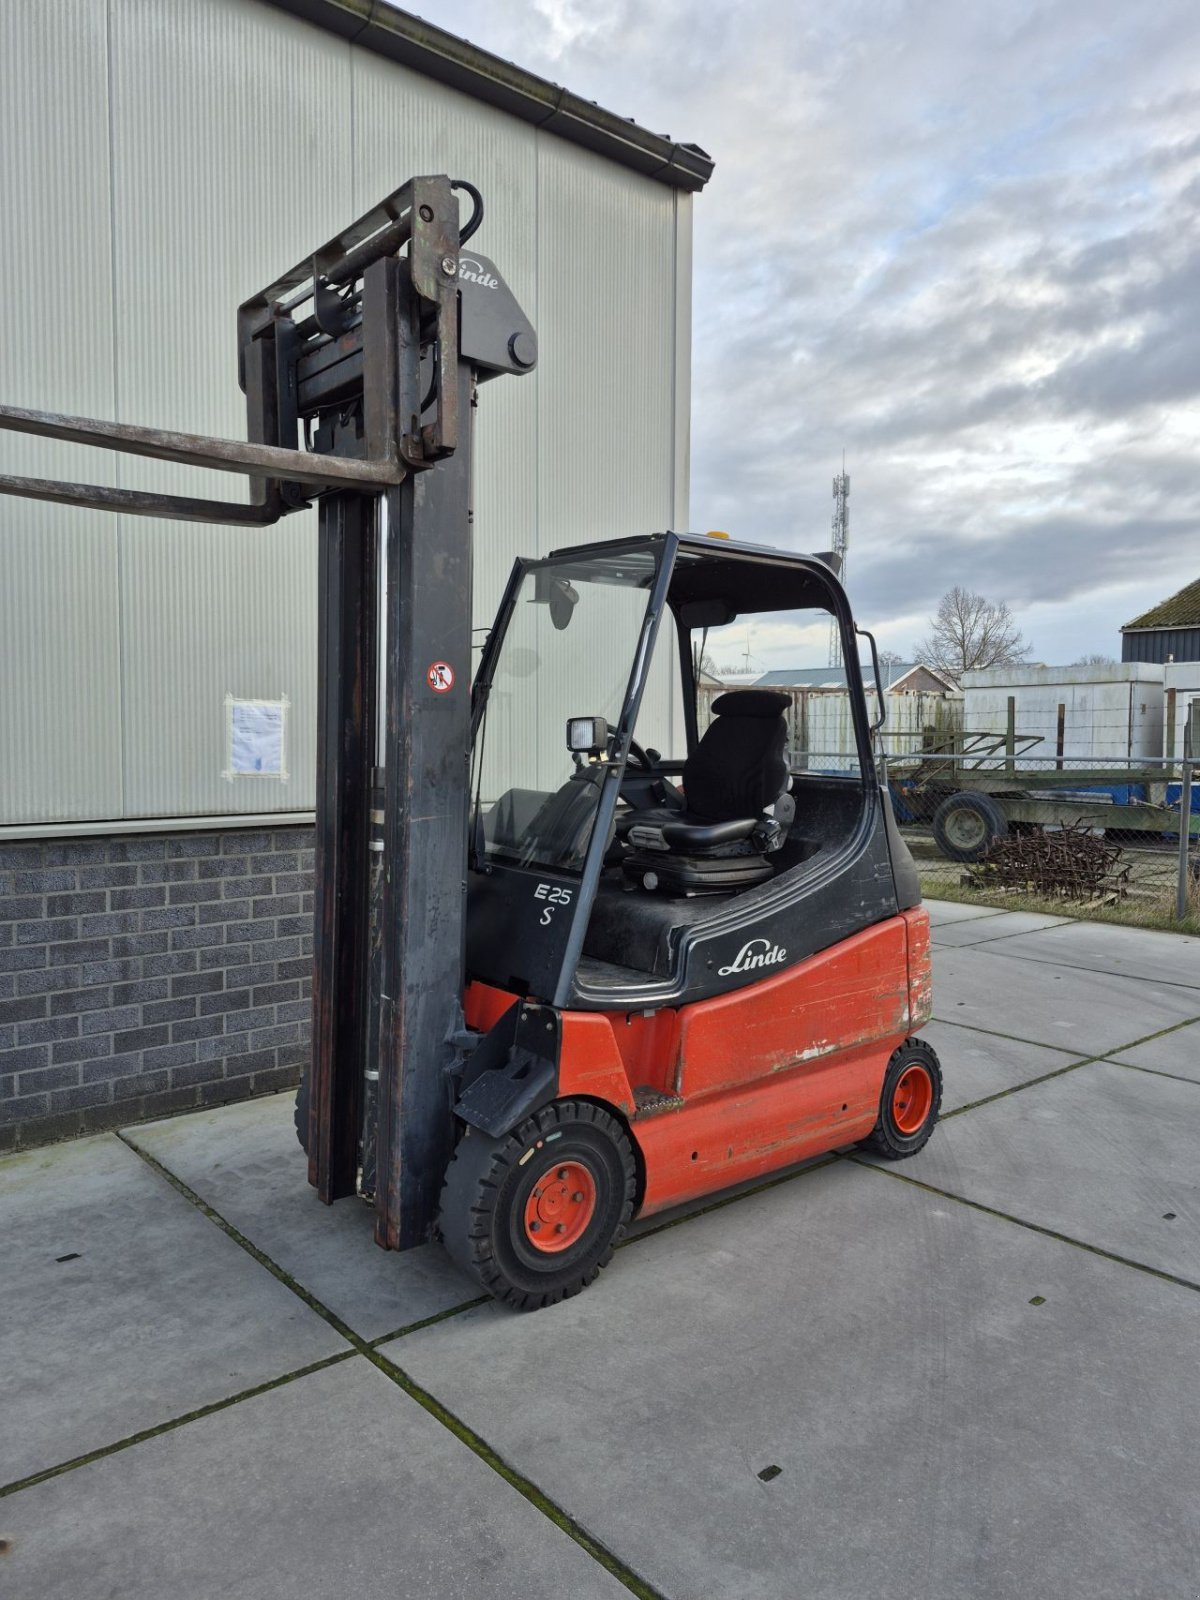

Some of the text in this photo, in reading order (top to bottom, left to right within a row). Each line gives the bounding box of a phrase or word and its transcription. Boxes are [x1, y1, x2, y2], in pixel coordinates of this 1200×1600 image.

[533, 883, 573, 905] E25
[540, 906, 555, 925] S
[717, 938, 788, 976] Linde
